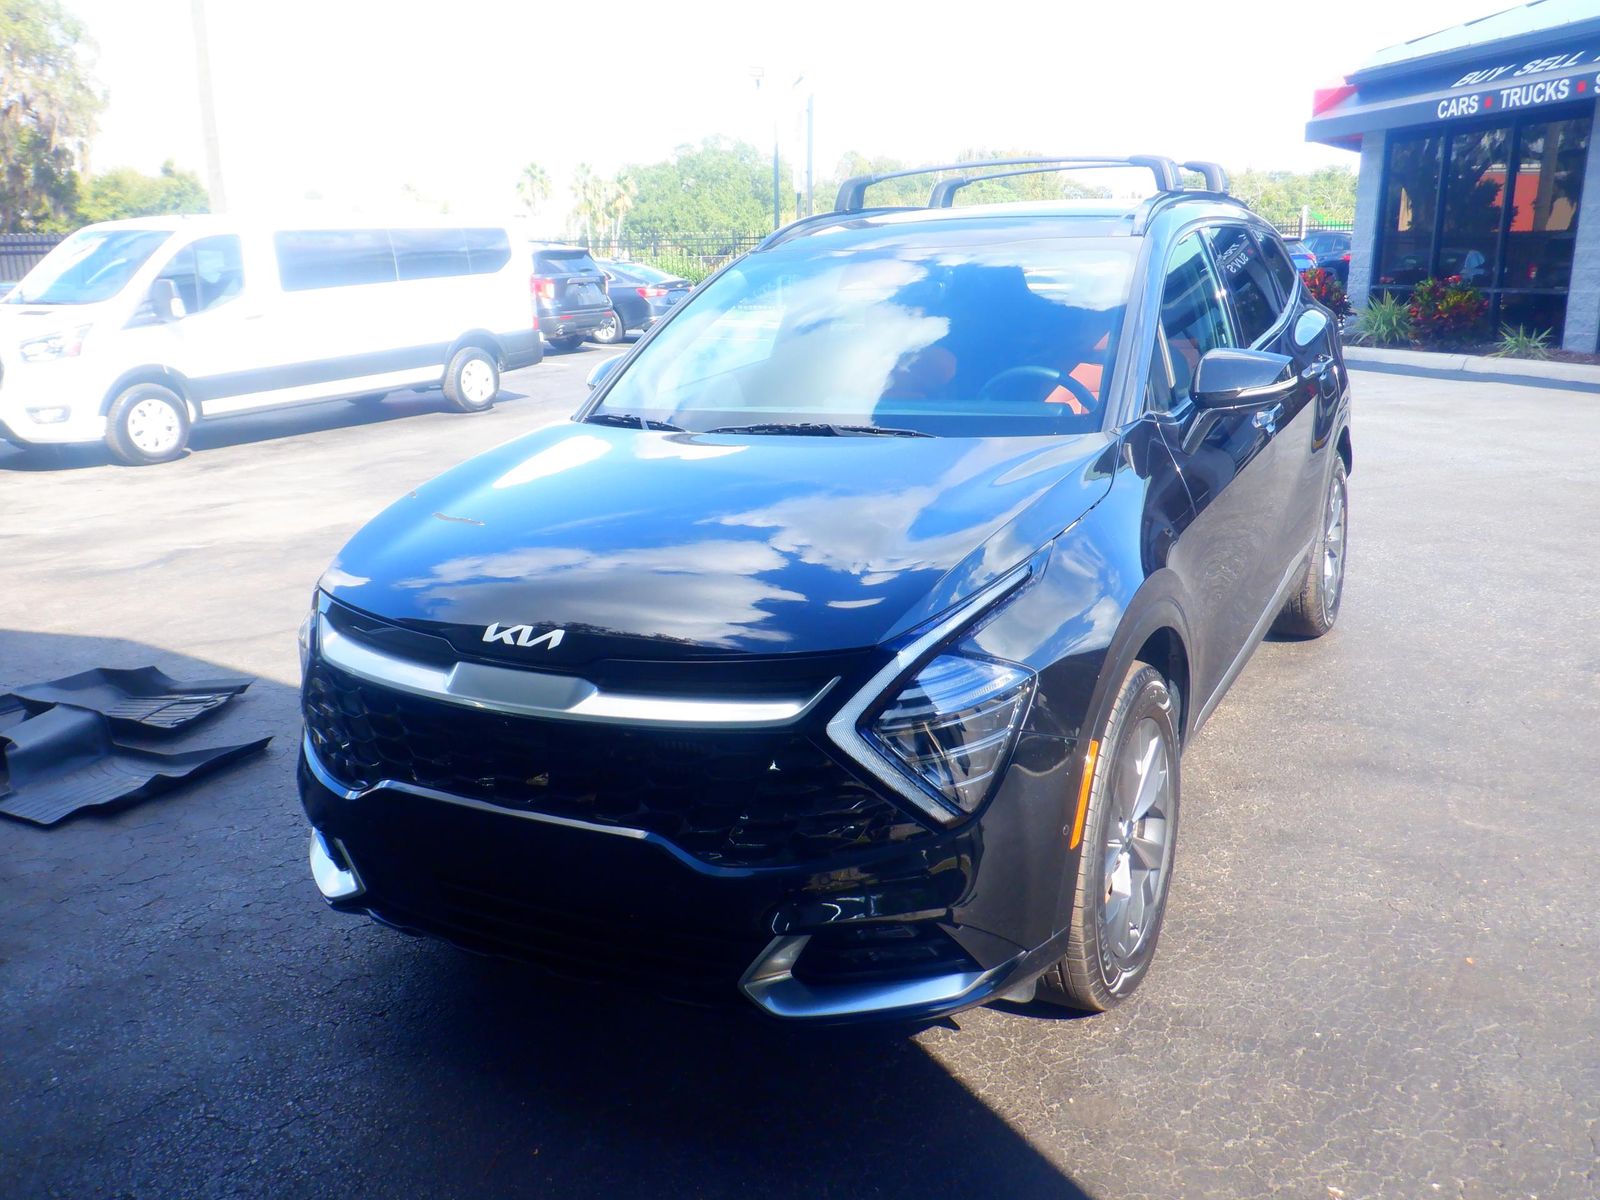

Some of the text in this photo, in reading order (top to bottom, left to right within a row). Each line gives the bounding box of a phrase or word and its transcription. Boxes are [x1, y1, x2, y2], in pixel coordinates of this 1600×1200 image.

[1451, 50, 1586, 88] BUY SELL
[1437, 94, 1479, 119] CARS
[1500, 78, 1570, 109] TRUCKS
[482, 622, 565, 650] KIA
